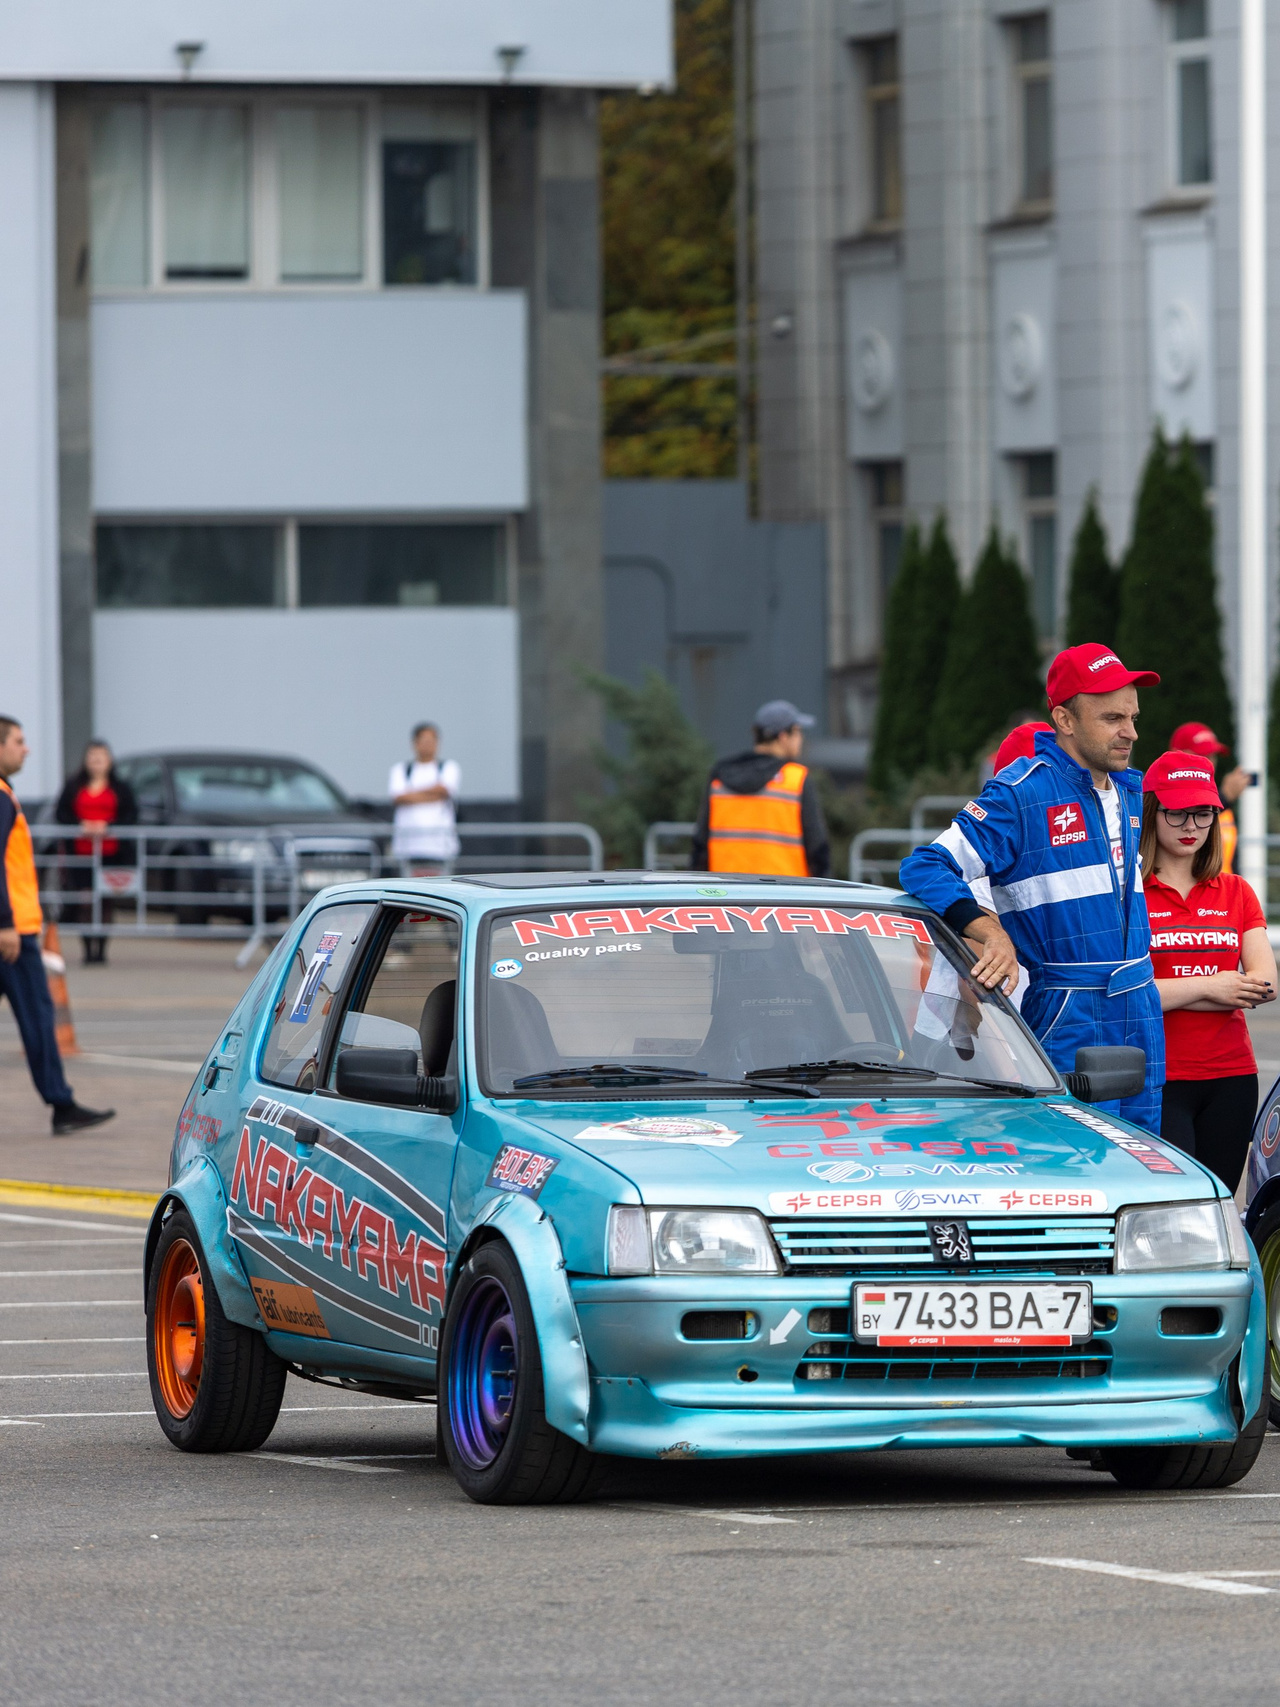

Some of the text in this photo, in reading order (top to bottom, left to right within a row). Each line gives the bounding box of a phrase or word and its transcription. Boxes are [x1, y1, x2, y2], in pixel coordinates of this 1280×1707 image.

[1052, 831, 1085, 846] CEPSA
[511, 906, 934, 946] NAKAYAMA
[525, 942, 642, 962] Quality parts
[497, 964, 515, 973] OK
[1172, 965, 1218, 976] TEAM
[192, 1113, 222, 1145] CEPSA
[768, 1141, 1020, 1158] CEPSA
[493, 1146, 553, 1189] ADT.BY
[873, 1163, 1025, 1176] SVIAT
[818, 1193, 1092, 1208] CEPSA SVIAT CEPSA
[230, 1124, 447, 1316] NAKAYAMA
[254, 1287, 326, 1330] Taif lubricants
[894, 1291, 1082, 1330] 7433 BA-7
[862, 1314, 881, 1329] BY
[994, 1336, 1021, 1345] maslo.by
